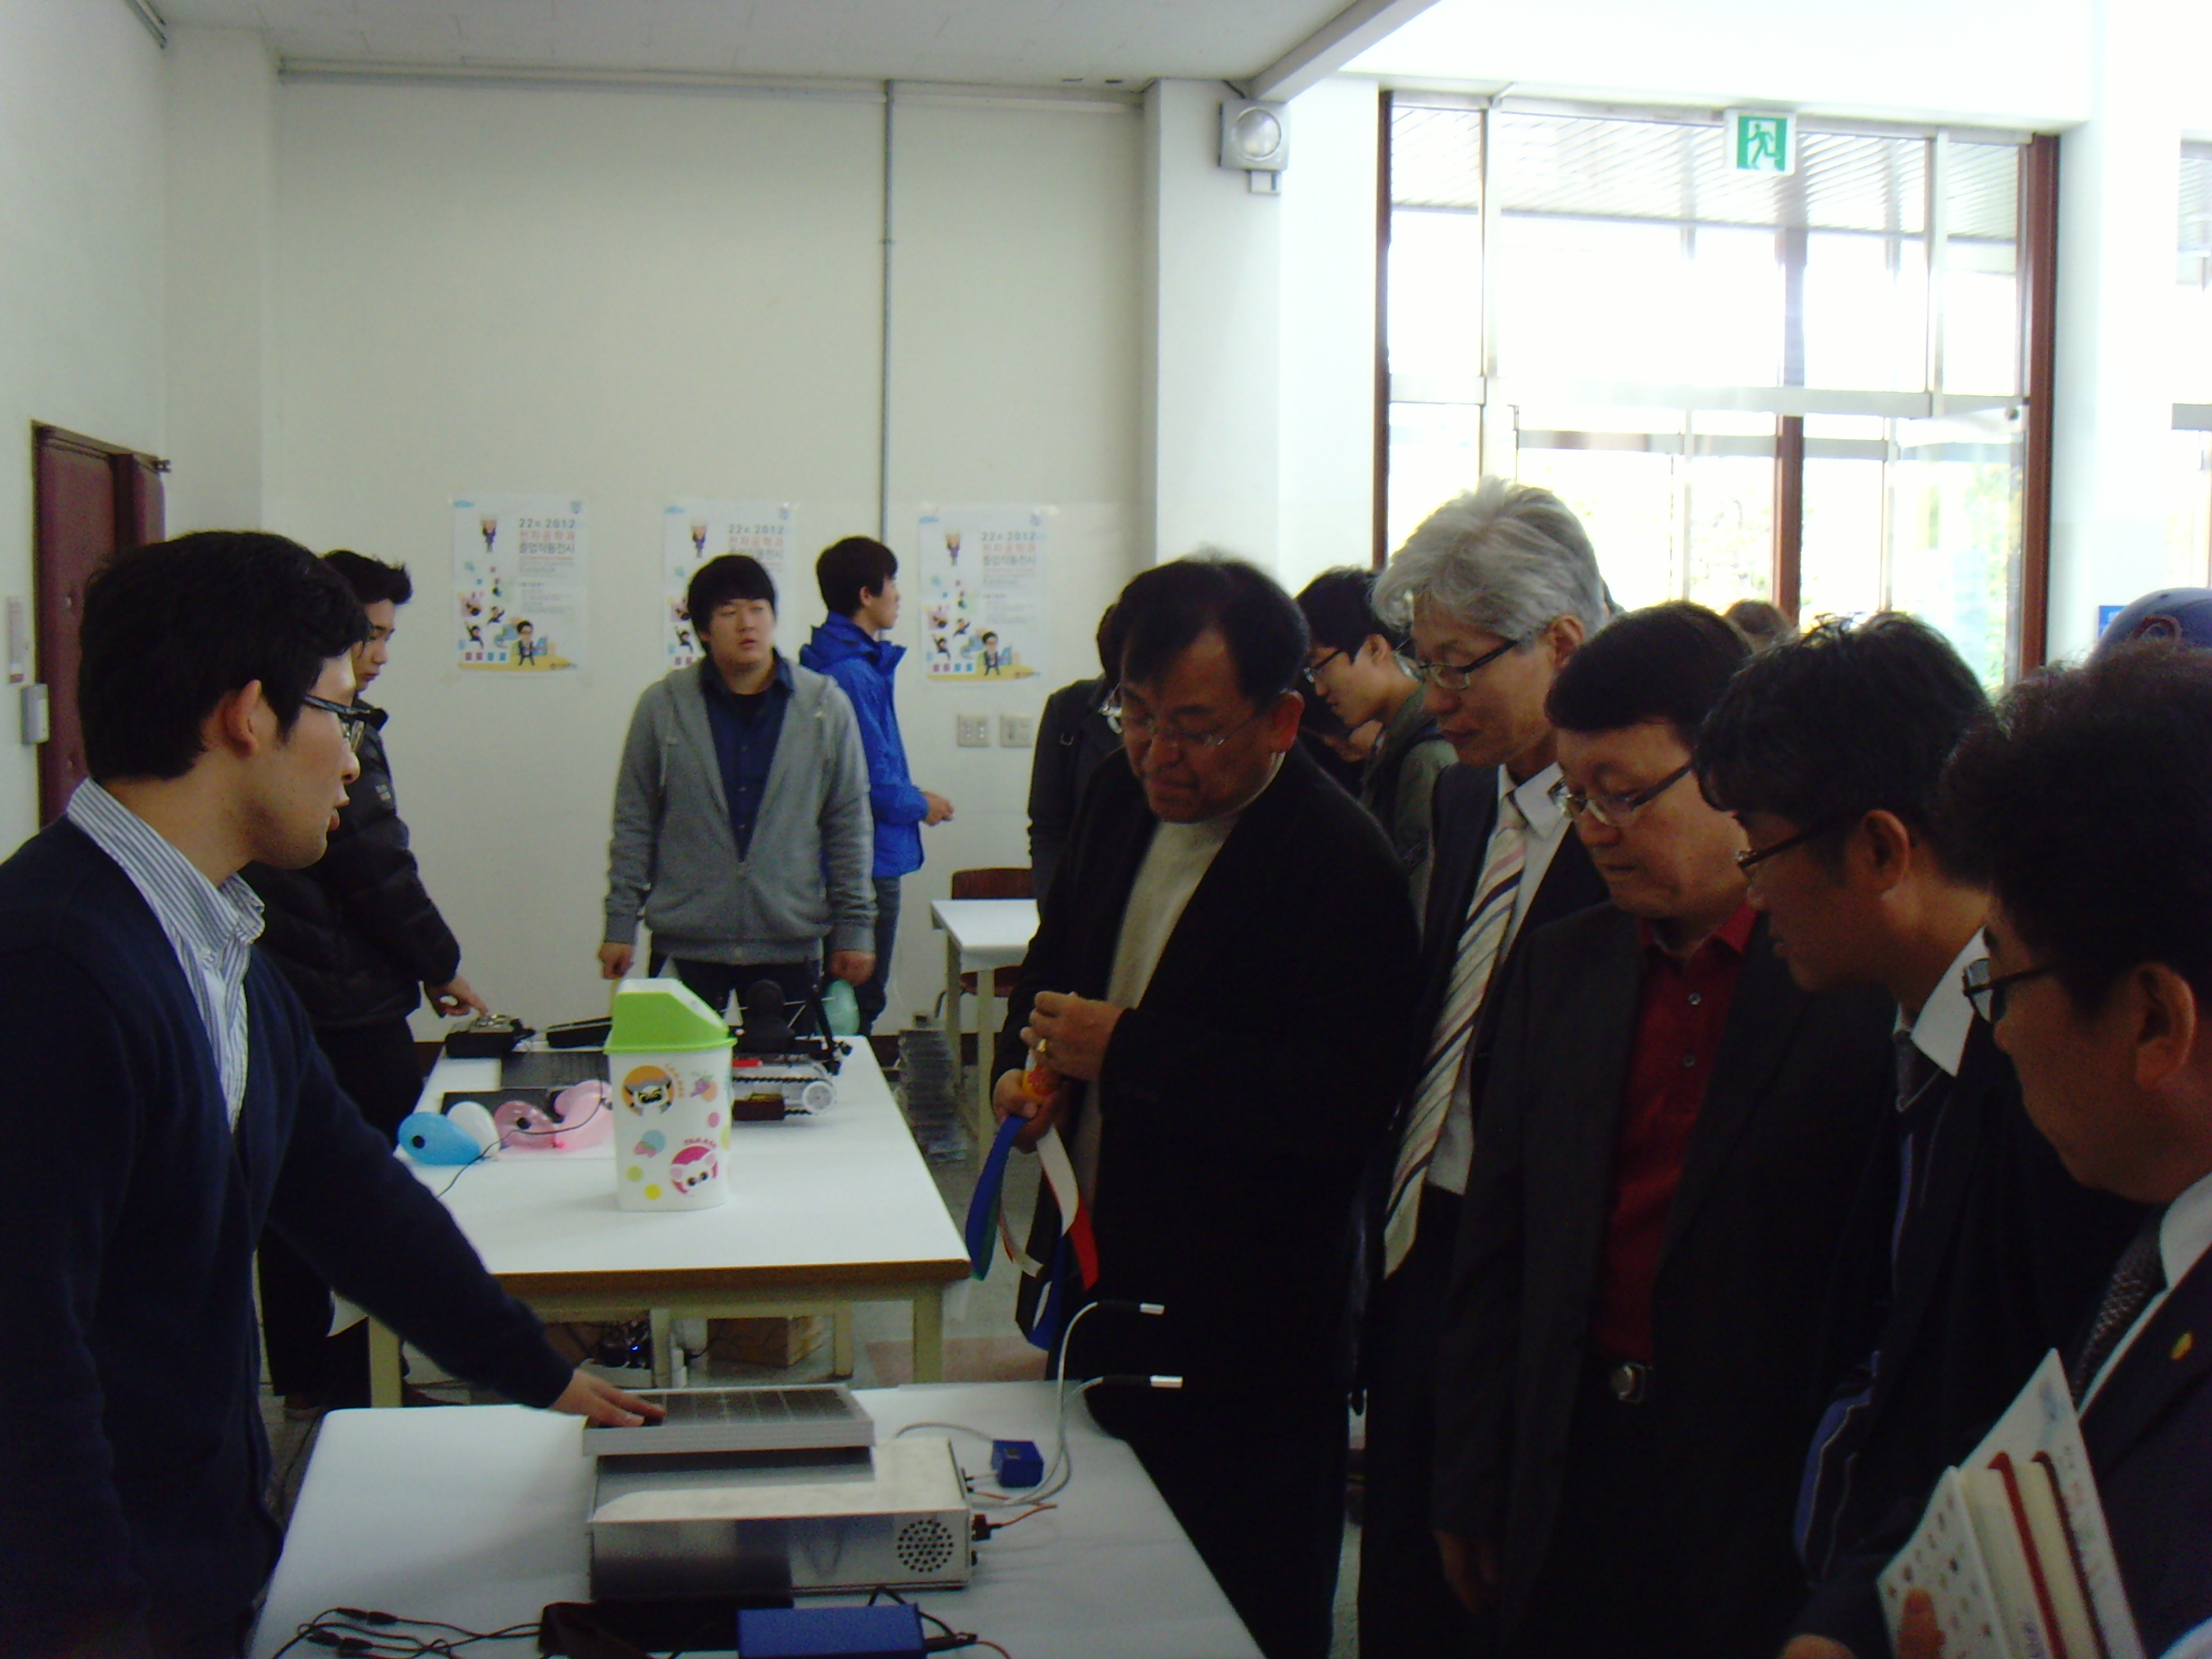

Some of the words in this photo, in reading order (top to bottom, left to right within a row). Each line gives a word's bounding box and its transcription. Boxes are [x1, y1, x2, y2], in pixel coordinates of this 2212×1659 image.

[546, 518, 576, 529] 2012
[755, 525, 785, 535] 2012
[1007, 532, 1036, 541] 2012
